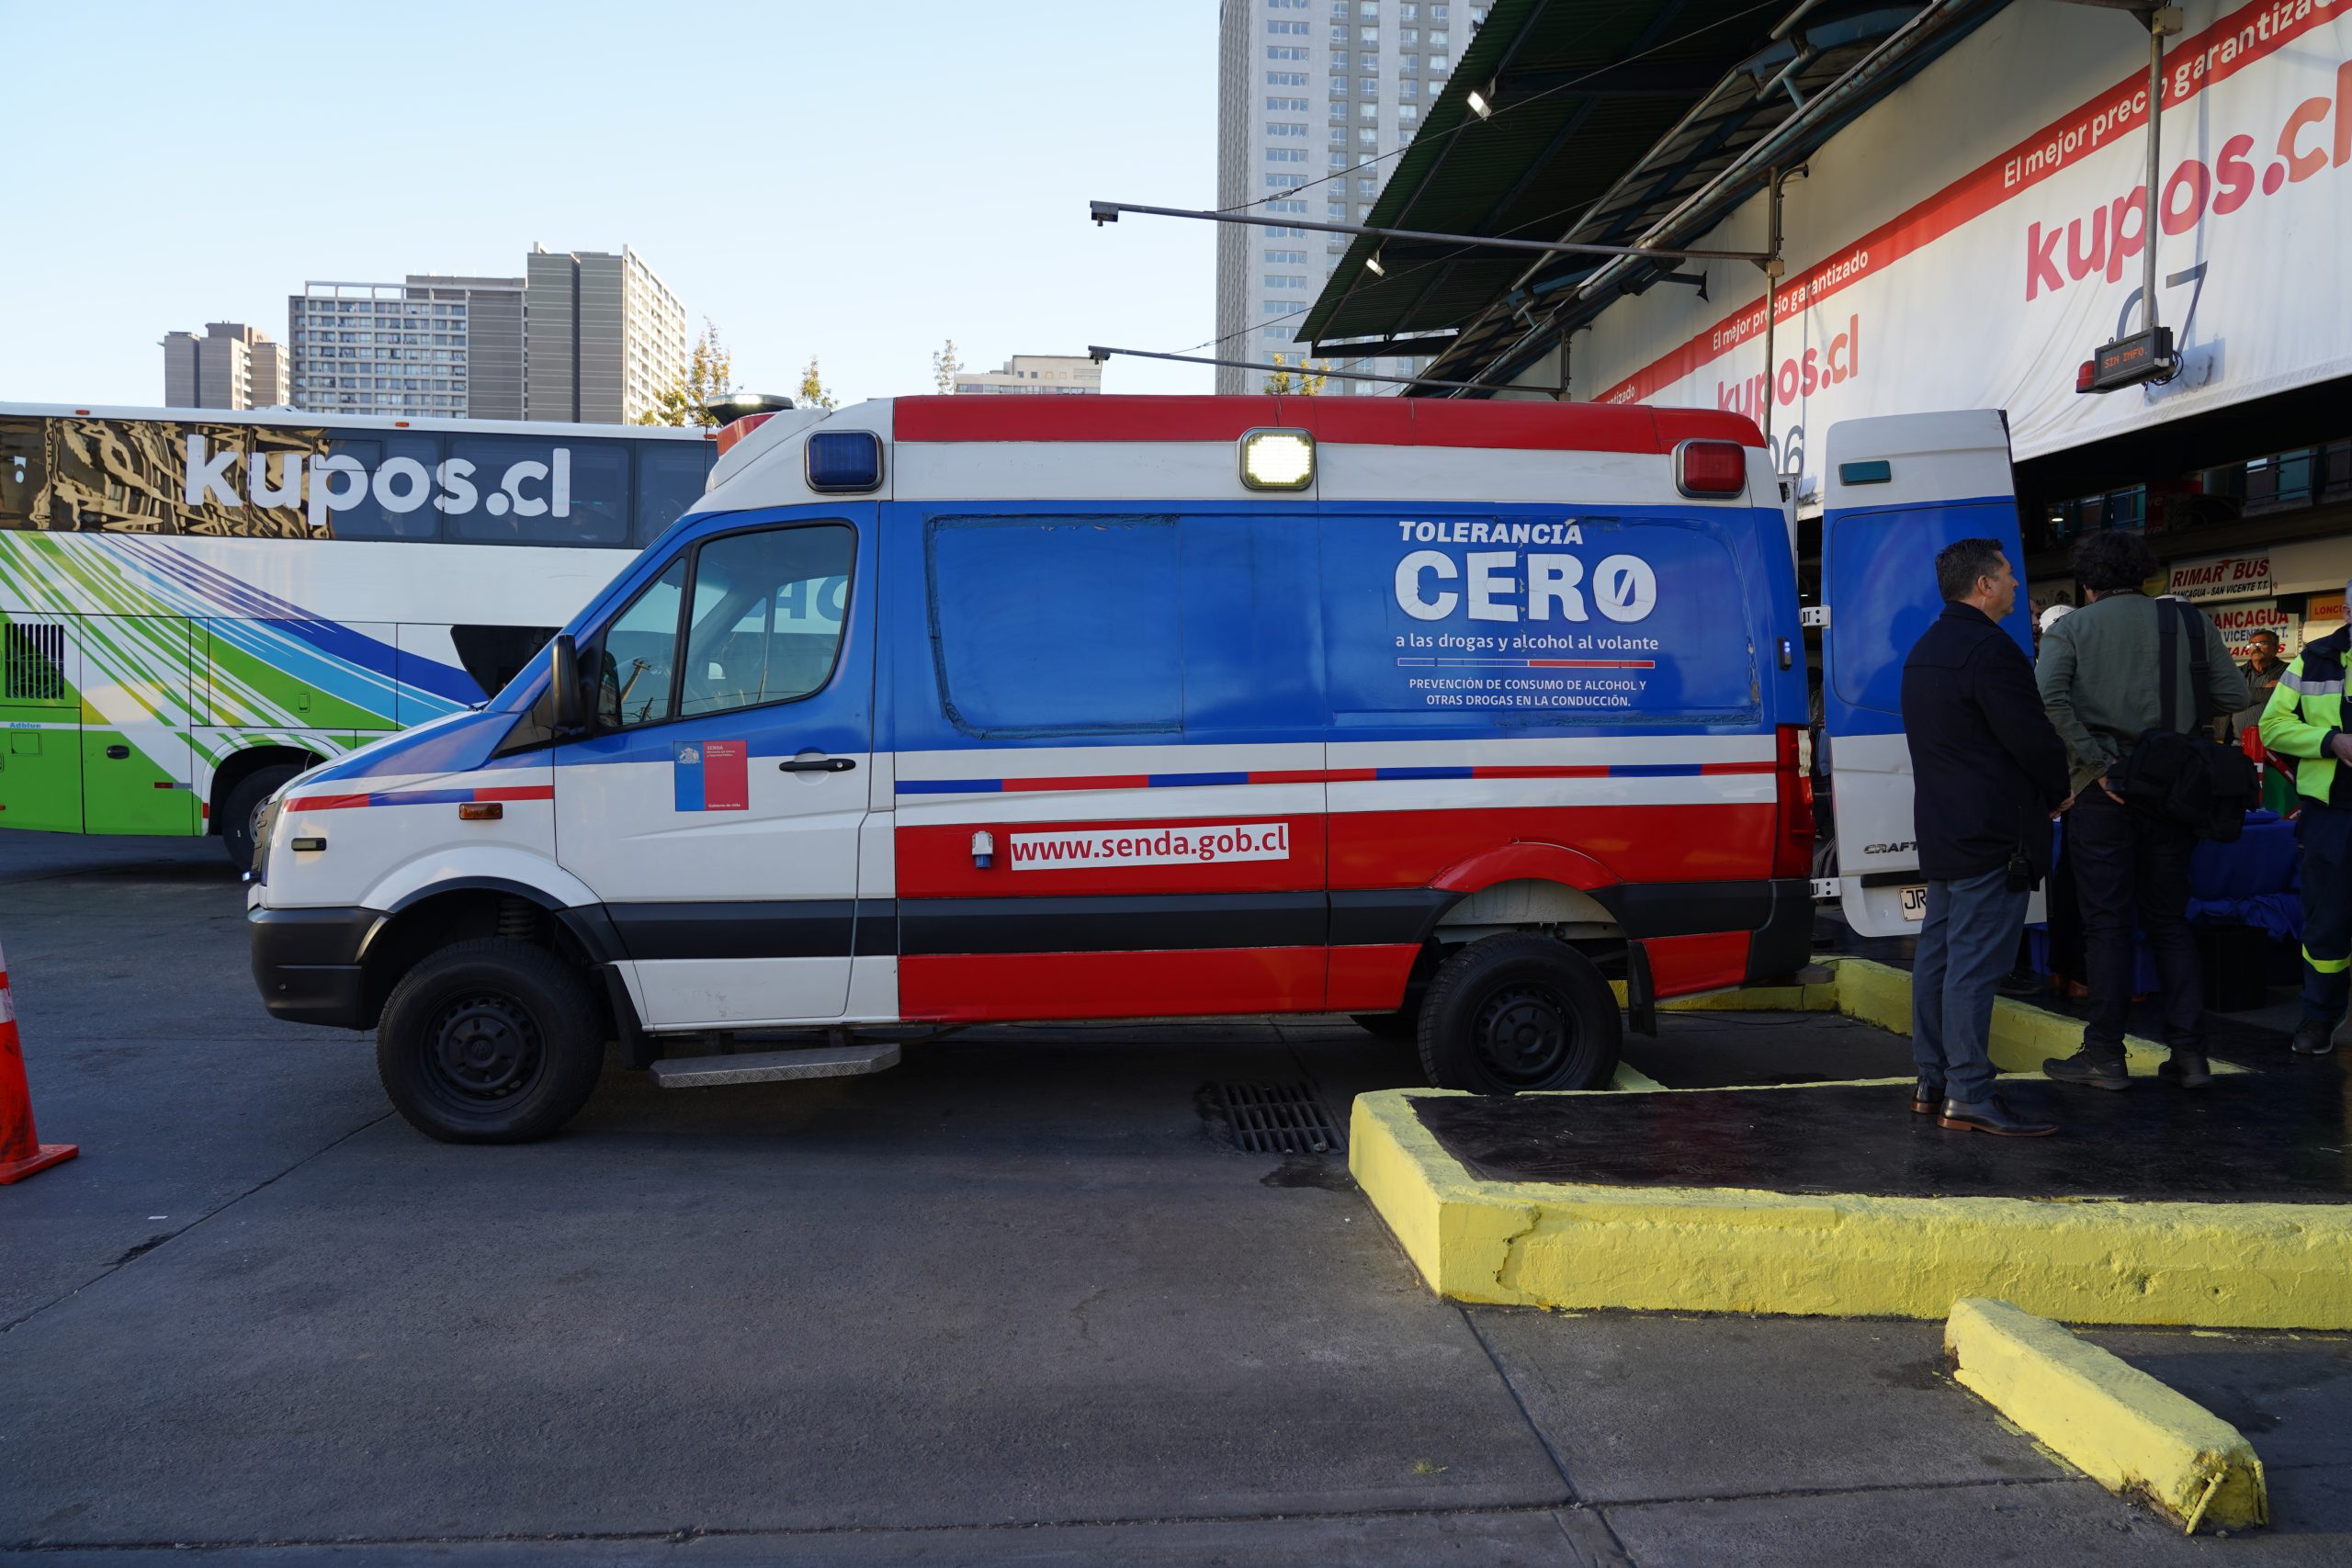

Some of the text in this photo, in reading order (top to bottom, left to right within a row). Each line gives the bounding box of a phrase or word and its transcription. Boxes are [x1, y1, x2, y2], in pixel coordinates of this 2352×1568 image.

[2004, 161, 2021, 189] El
[2025, 127, 2087, 176] mejor
[2092, 77, 2168, 146] prec
[2025, 60, 2352, 302] kupos.cl
[1713, 331, 1722, 351] El
[1723, 317, 1751, 345] mejor
[1791, 249, 1869, 312] garantizado
[2104, 355, 2120, 367] SIN
[185, 434, 571, 526] kupos.cl
[2172, 558, 2269, 587] RIMAR BUS
[2211, 587, 2224, 596] SAN
[2226, 582, 2256, 594] VICENTE
[2208, 609, 2289, 629] ANCAGUA
[1396, 633, 1659, 651] a las drogas y alcohol al volante
[1409, 677, 1647, 691] PREVENCIÓN DE CONSUMO DE ALCOHOL Y
[1426, 694, 1631, 706] OTRAS DROGAS EN LA CONDUCCIÓN.
[1011, 825, 1287, 862] www.senda.gob.cl
[1864, 840, 1918, 854] CRAFT
